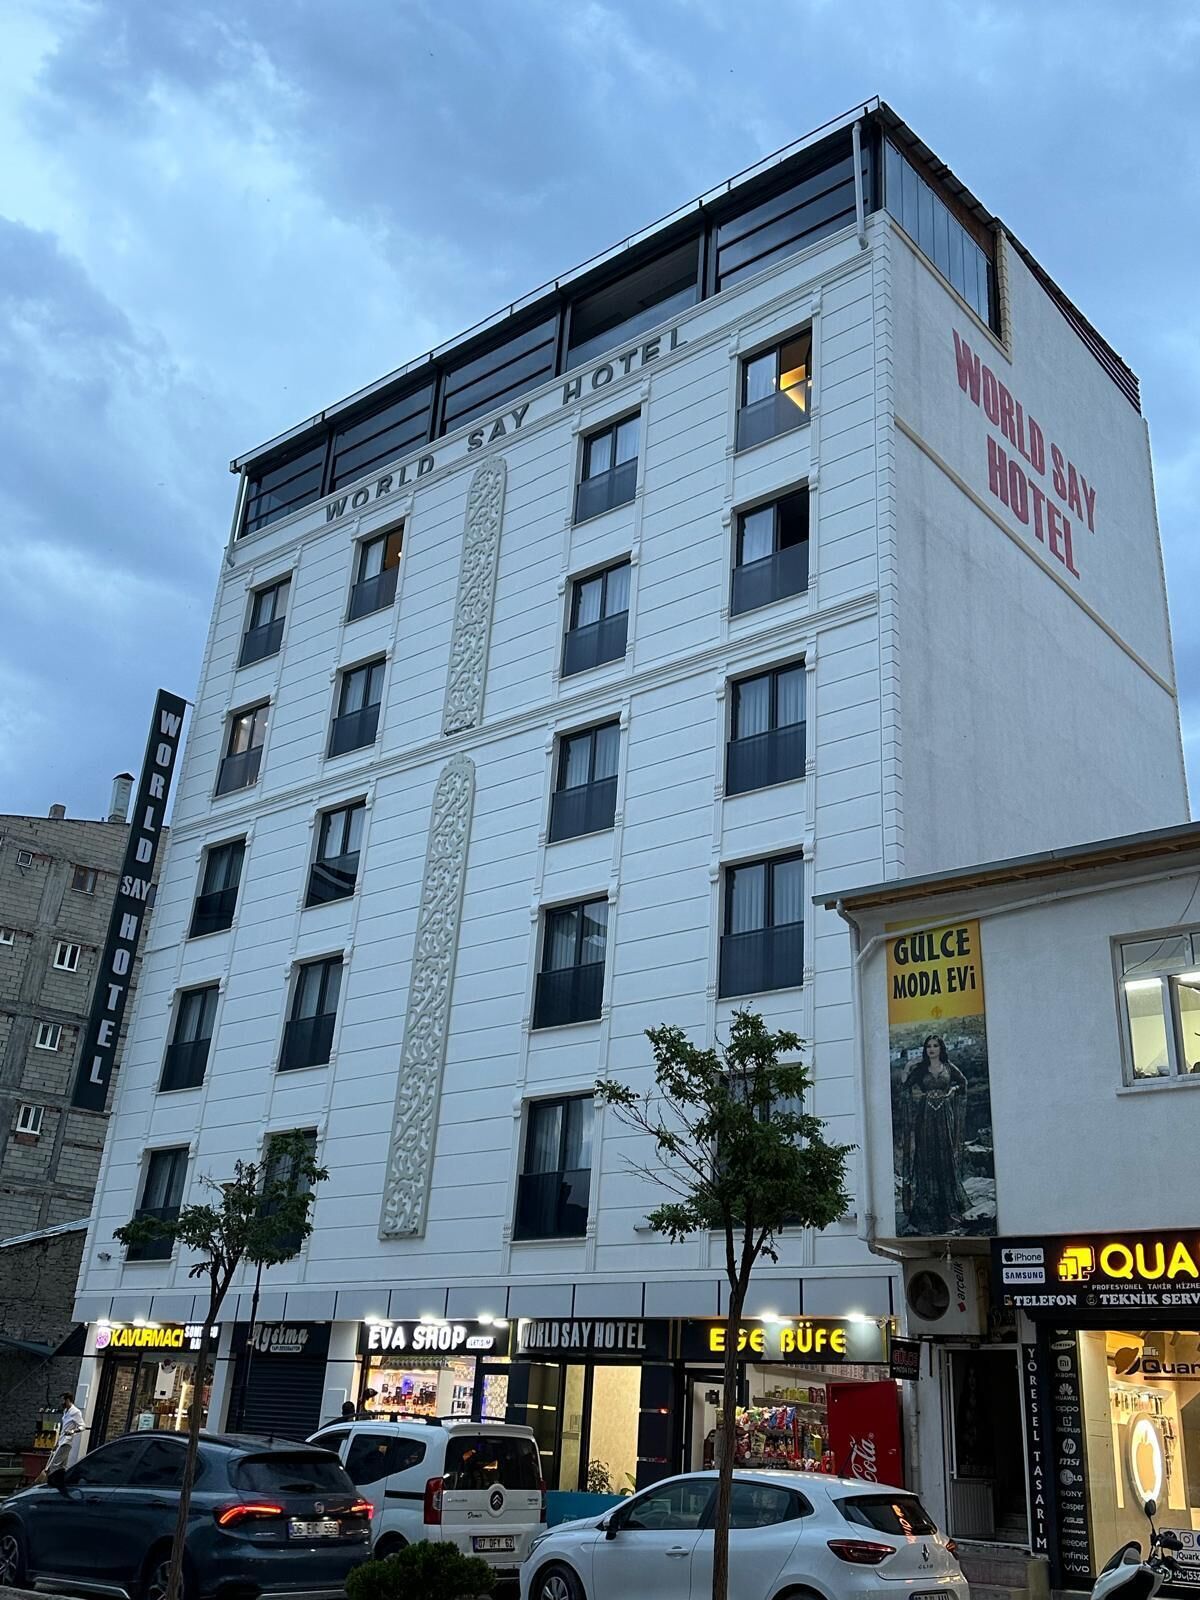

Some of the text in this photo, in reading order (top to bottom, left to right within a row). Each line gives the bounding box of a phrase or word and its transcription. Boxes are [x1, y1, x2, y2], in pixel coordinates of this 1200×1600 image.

[325, 327, 689, 523] WORLD SAY HOTEL
[952, 327, 1096, 535] WORLD SAY
[986, 433, 1080, 581] HOTEL
[89, 709, 182, 1085] WORLD SAY HOTEL
[894, 926, 971, 966] GÜLCE
[893, 970, 942, 1000] MODA
[1014, 1252, 1042, 1262] iPhone
[1005, 1271, 1043, 1280] SAMSUNG
[1091, 1283, 1143, 1291] PROFESYONEL
[1014, 1294, 1077, 1306] TELEFON
[1100, 1291, 1159, 1305] TEKNİK
[110, 1327, 184, 1347] KAVURMACI
[368, 1326, 406, 1350] EVA
[412, 1324, 467, 1350] SHOP
[521, 1322, 647, 1349] WORLD SAY HOTEL
[780, 1321, 848, 1353] BÜFE
[1027, 1347, 1047, 1549] YÖRESEL TASARIM
[1059, 1458, 1080, 1466] msi
[1073, 1474, 1083, 1482] LG
[1060, 1490, 1083, 1498] SONY
[1061, 1502, 1085, 1511] Casper
[1064, 1562, 1090, 1573] vivo
